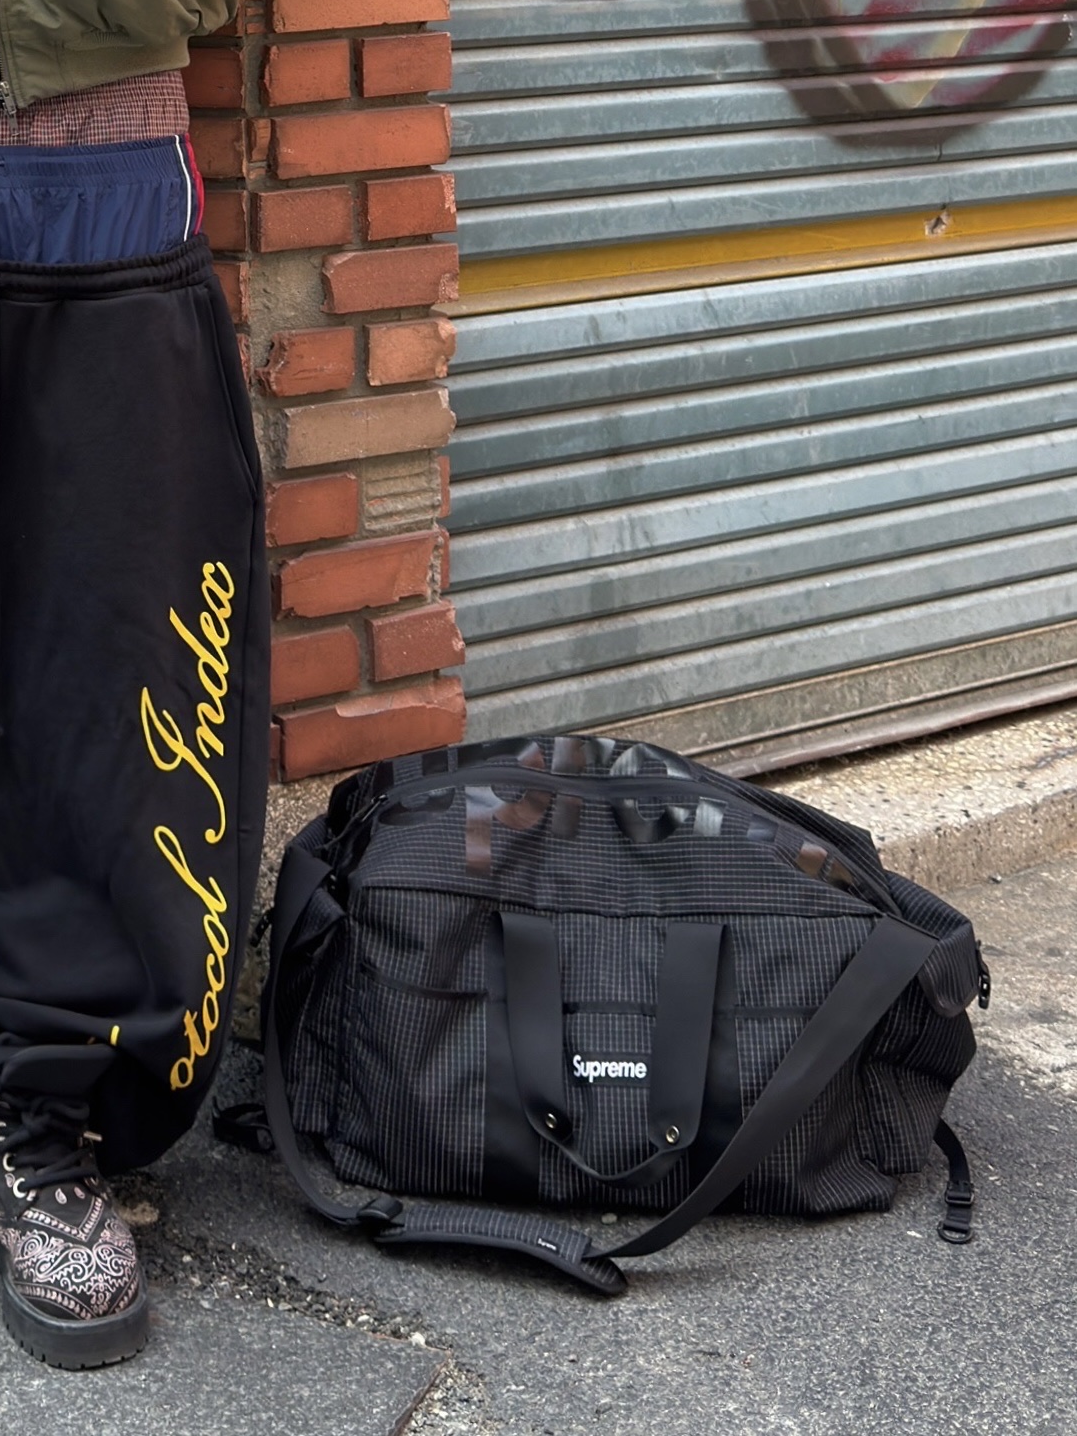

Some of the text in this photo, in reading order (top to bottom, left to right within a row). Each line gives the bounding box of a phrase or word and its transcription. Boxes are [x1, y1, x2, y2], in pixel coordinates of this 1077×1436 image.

[140, 560, 236, 845] Index
[153, 824, 231, 1092] otocol
[572, 1054, 647, 1083] Supreme
